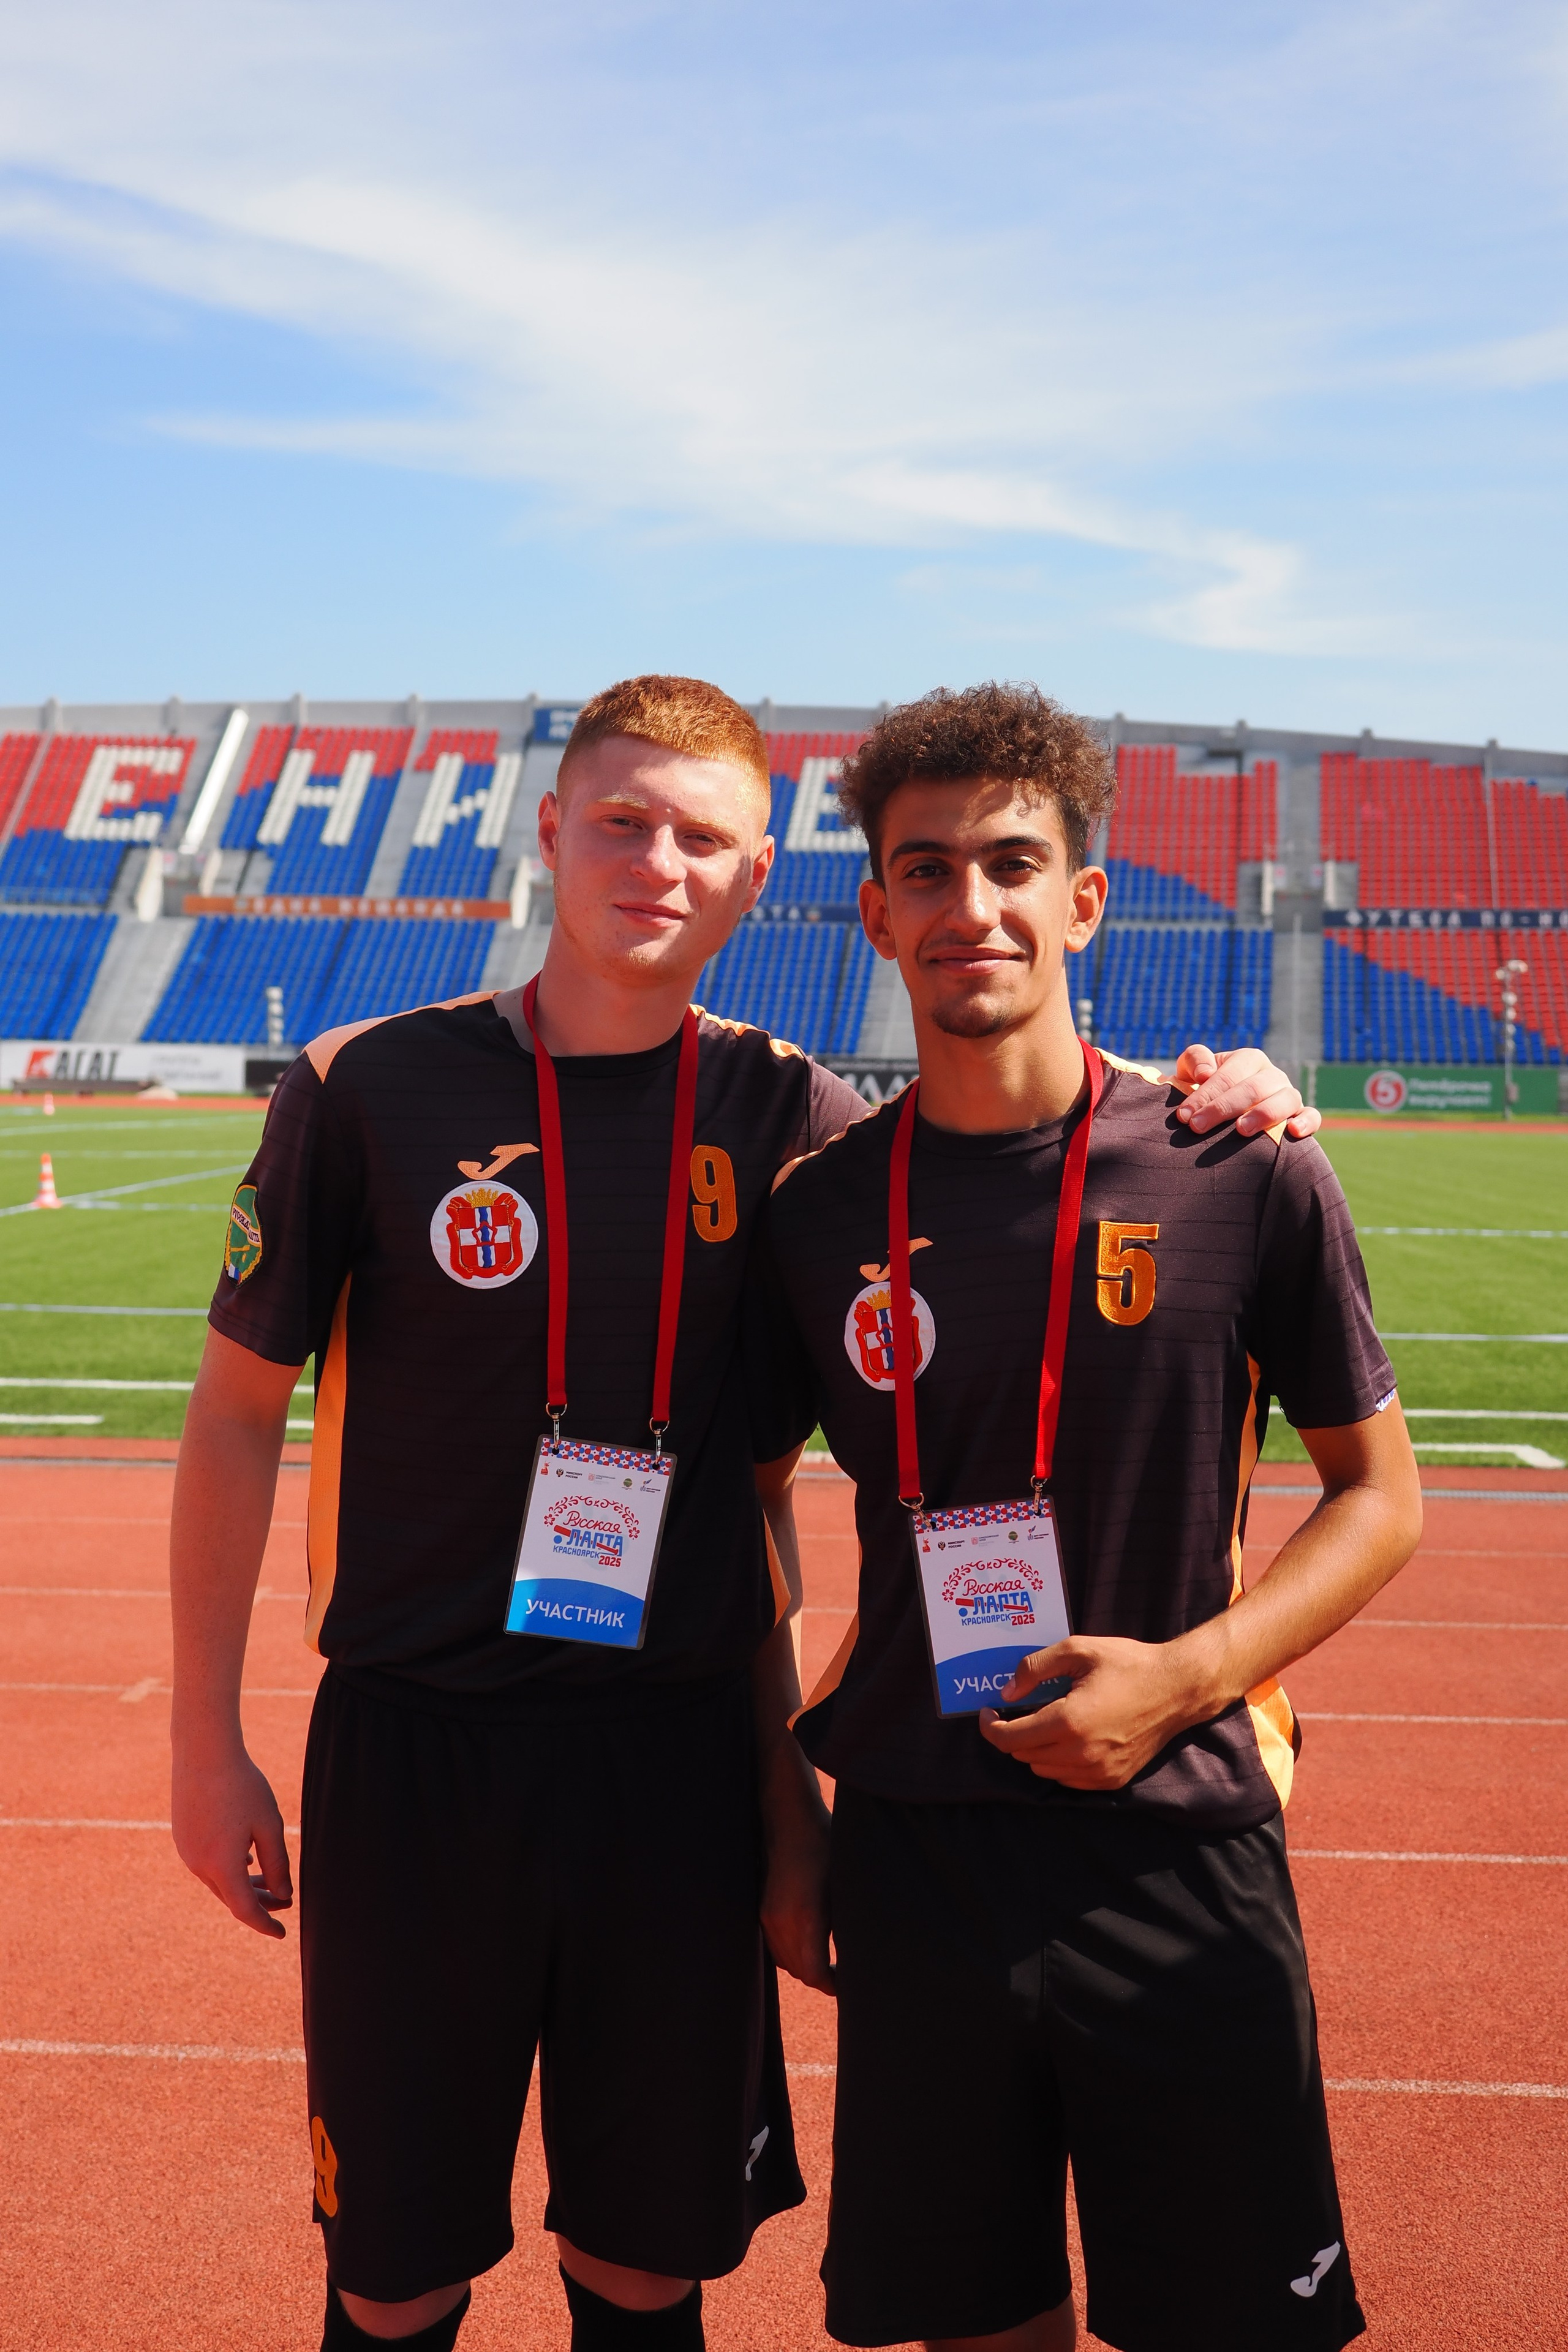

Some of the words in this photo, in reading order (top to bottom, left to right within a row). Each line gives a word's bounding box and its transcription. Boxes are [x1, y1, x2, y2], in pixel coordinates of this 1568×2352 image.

[690, 1144, 737, 1243] 9
[1096, 1220, 1159, 1326] 5
[562, 1510, 622, 1534] Русская
[552, 1545, 600, 1559] КРАСНОЯРСК
[567, 1529, 624, 1557] ЛАПТА
[598, 1555, 622, 1567] 2025
[962, 1578, 1025, 1596] Русская
[526, 1598, 625, 1629] УЧАСТНИК
[973, 1591, 1033, 1615] ЛАПТА
[961, 1613, 1011, 1626] КРАСНОЯРСК
[1011, 1614, 1035, 1626] 2025
